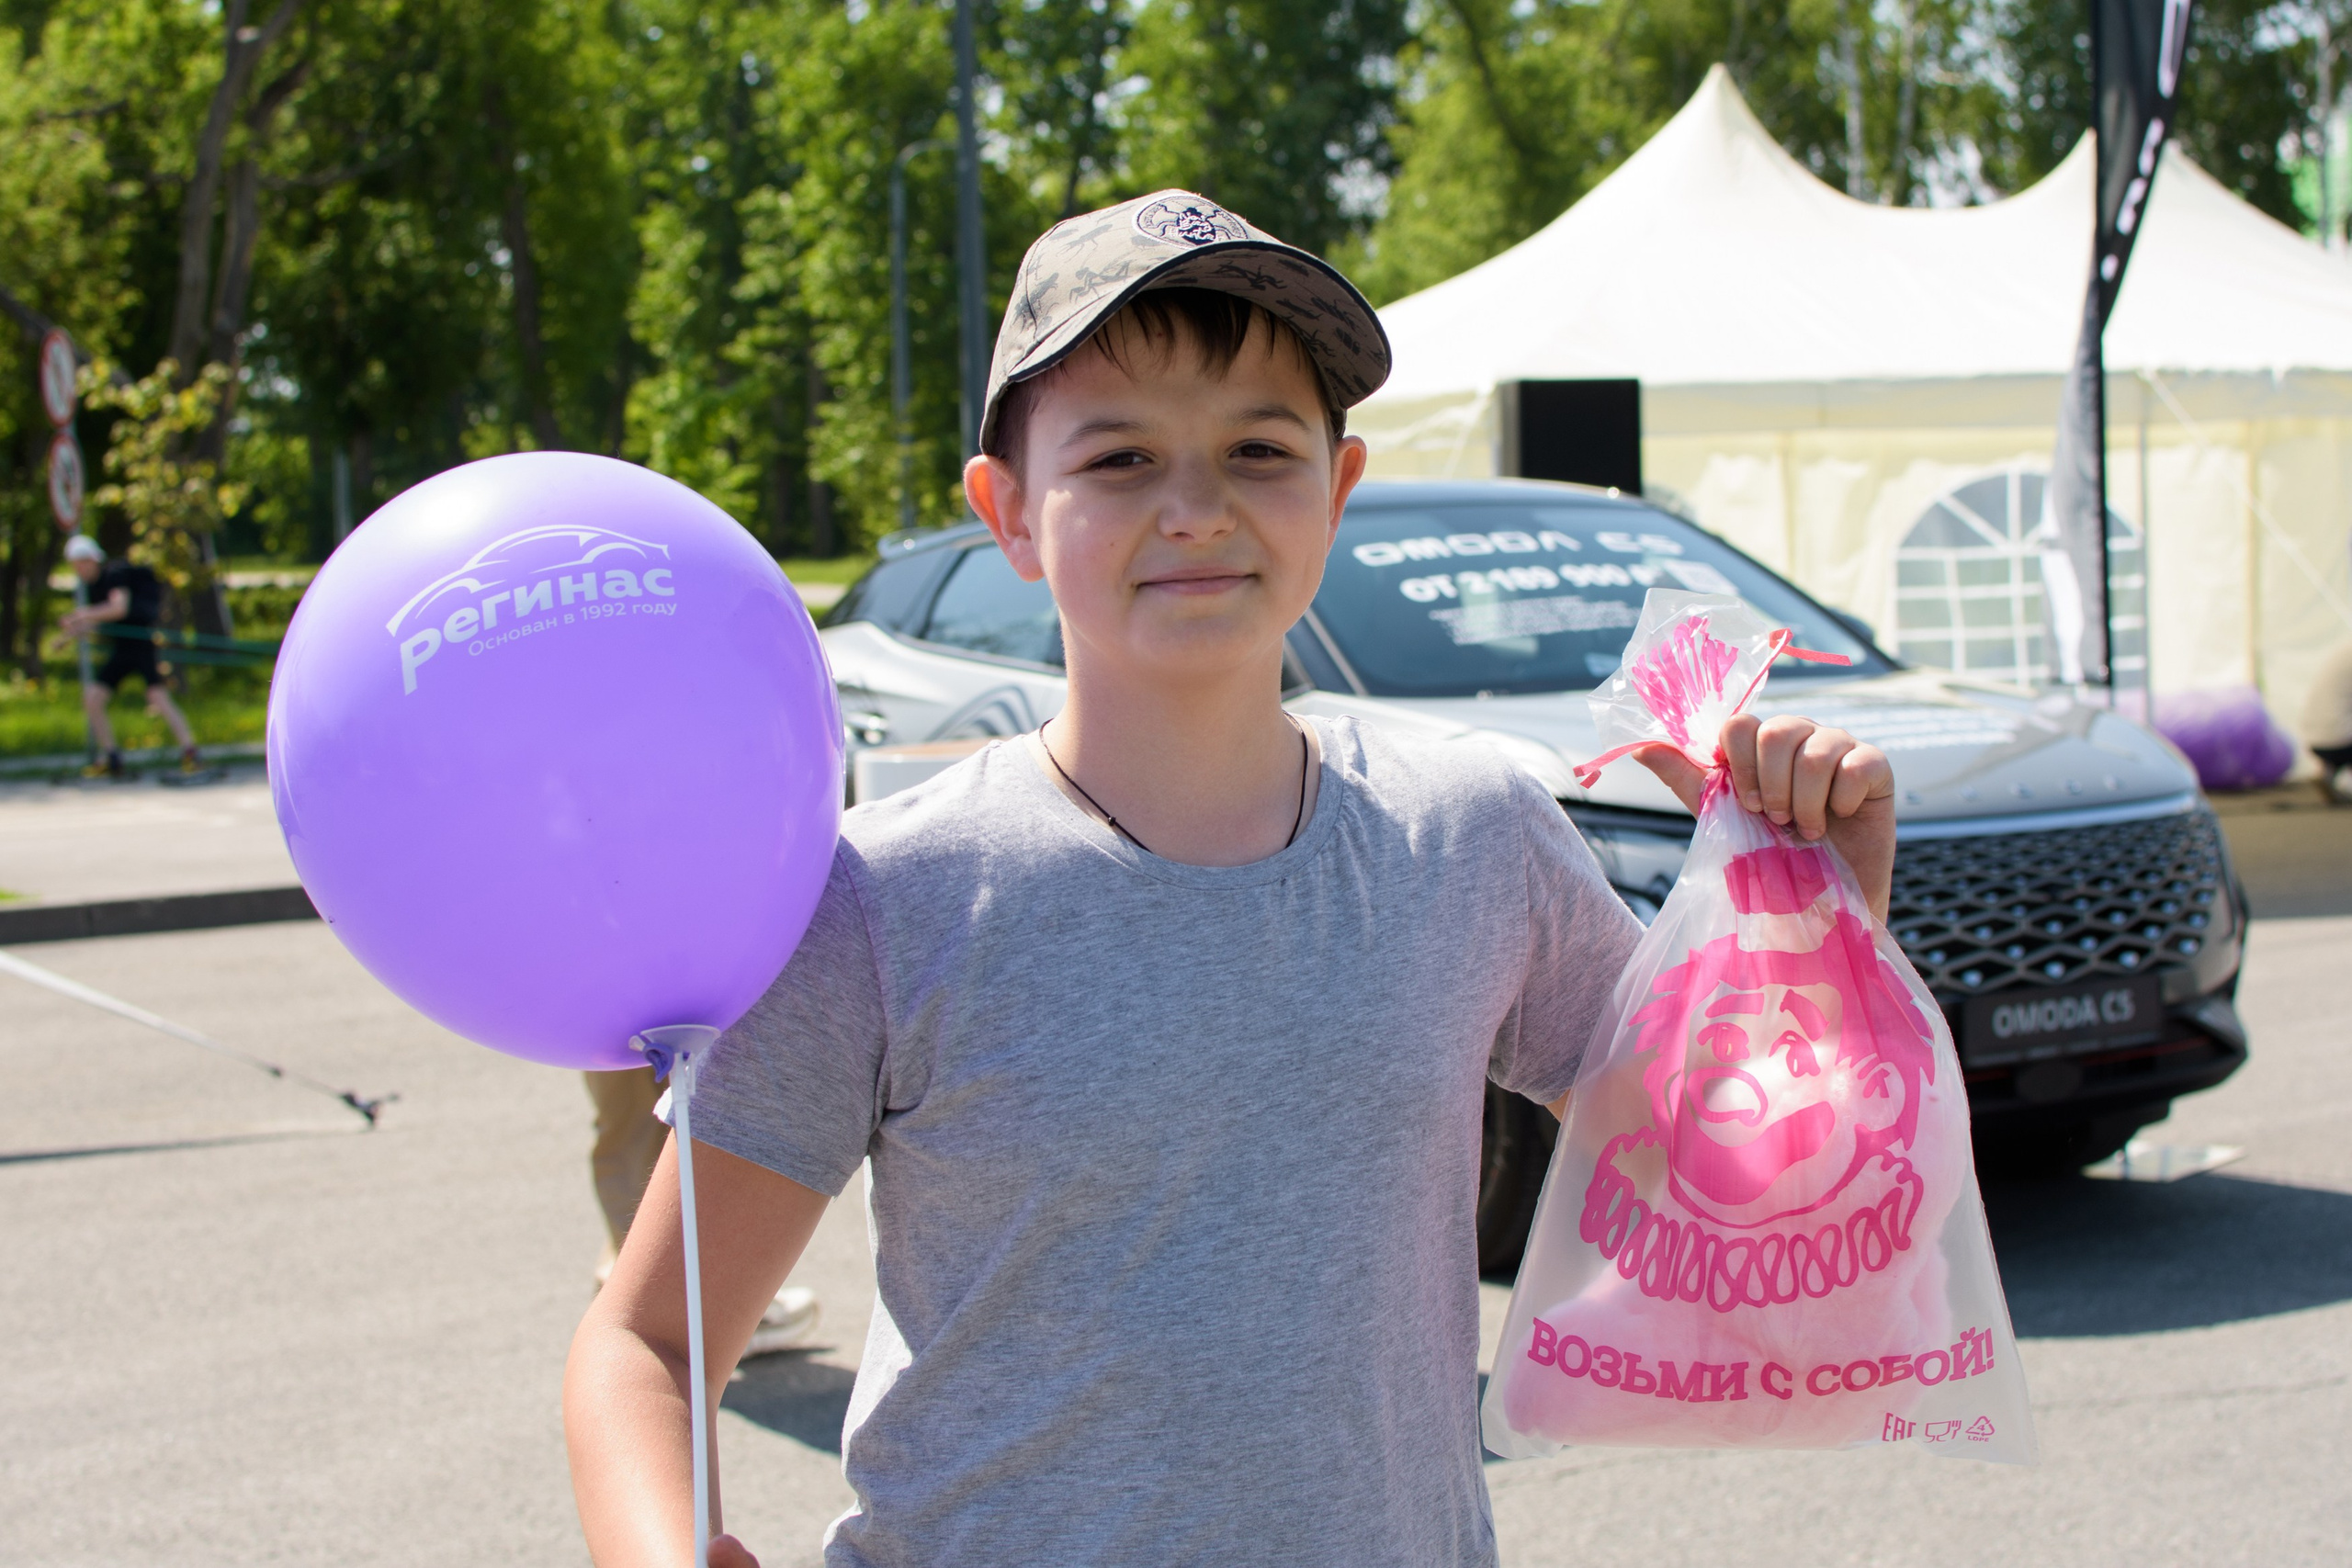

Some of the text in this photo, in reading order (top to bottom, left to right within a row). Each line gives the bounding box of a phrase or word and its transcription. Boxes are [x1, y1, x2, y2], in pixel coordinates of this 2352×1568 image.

[468, 602, 678, 657] Основан в 1992 году
[1992, 989, 2136, 1039] OMODA C5
[1527, 1316, 1995, 1403] ВОЗЬМИ С СОБОЙ!
[1967, 1435, 1990, 1443] LDPE
